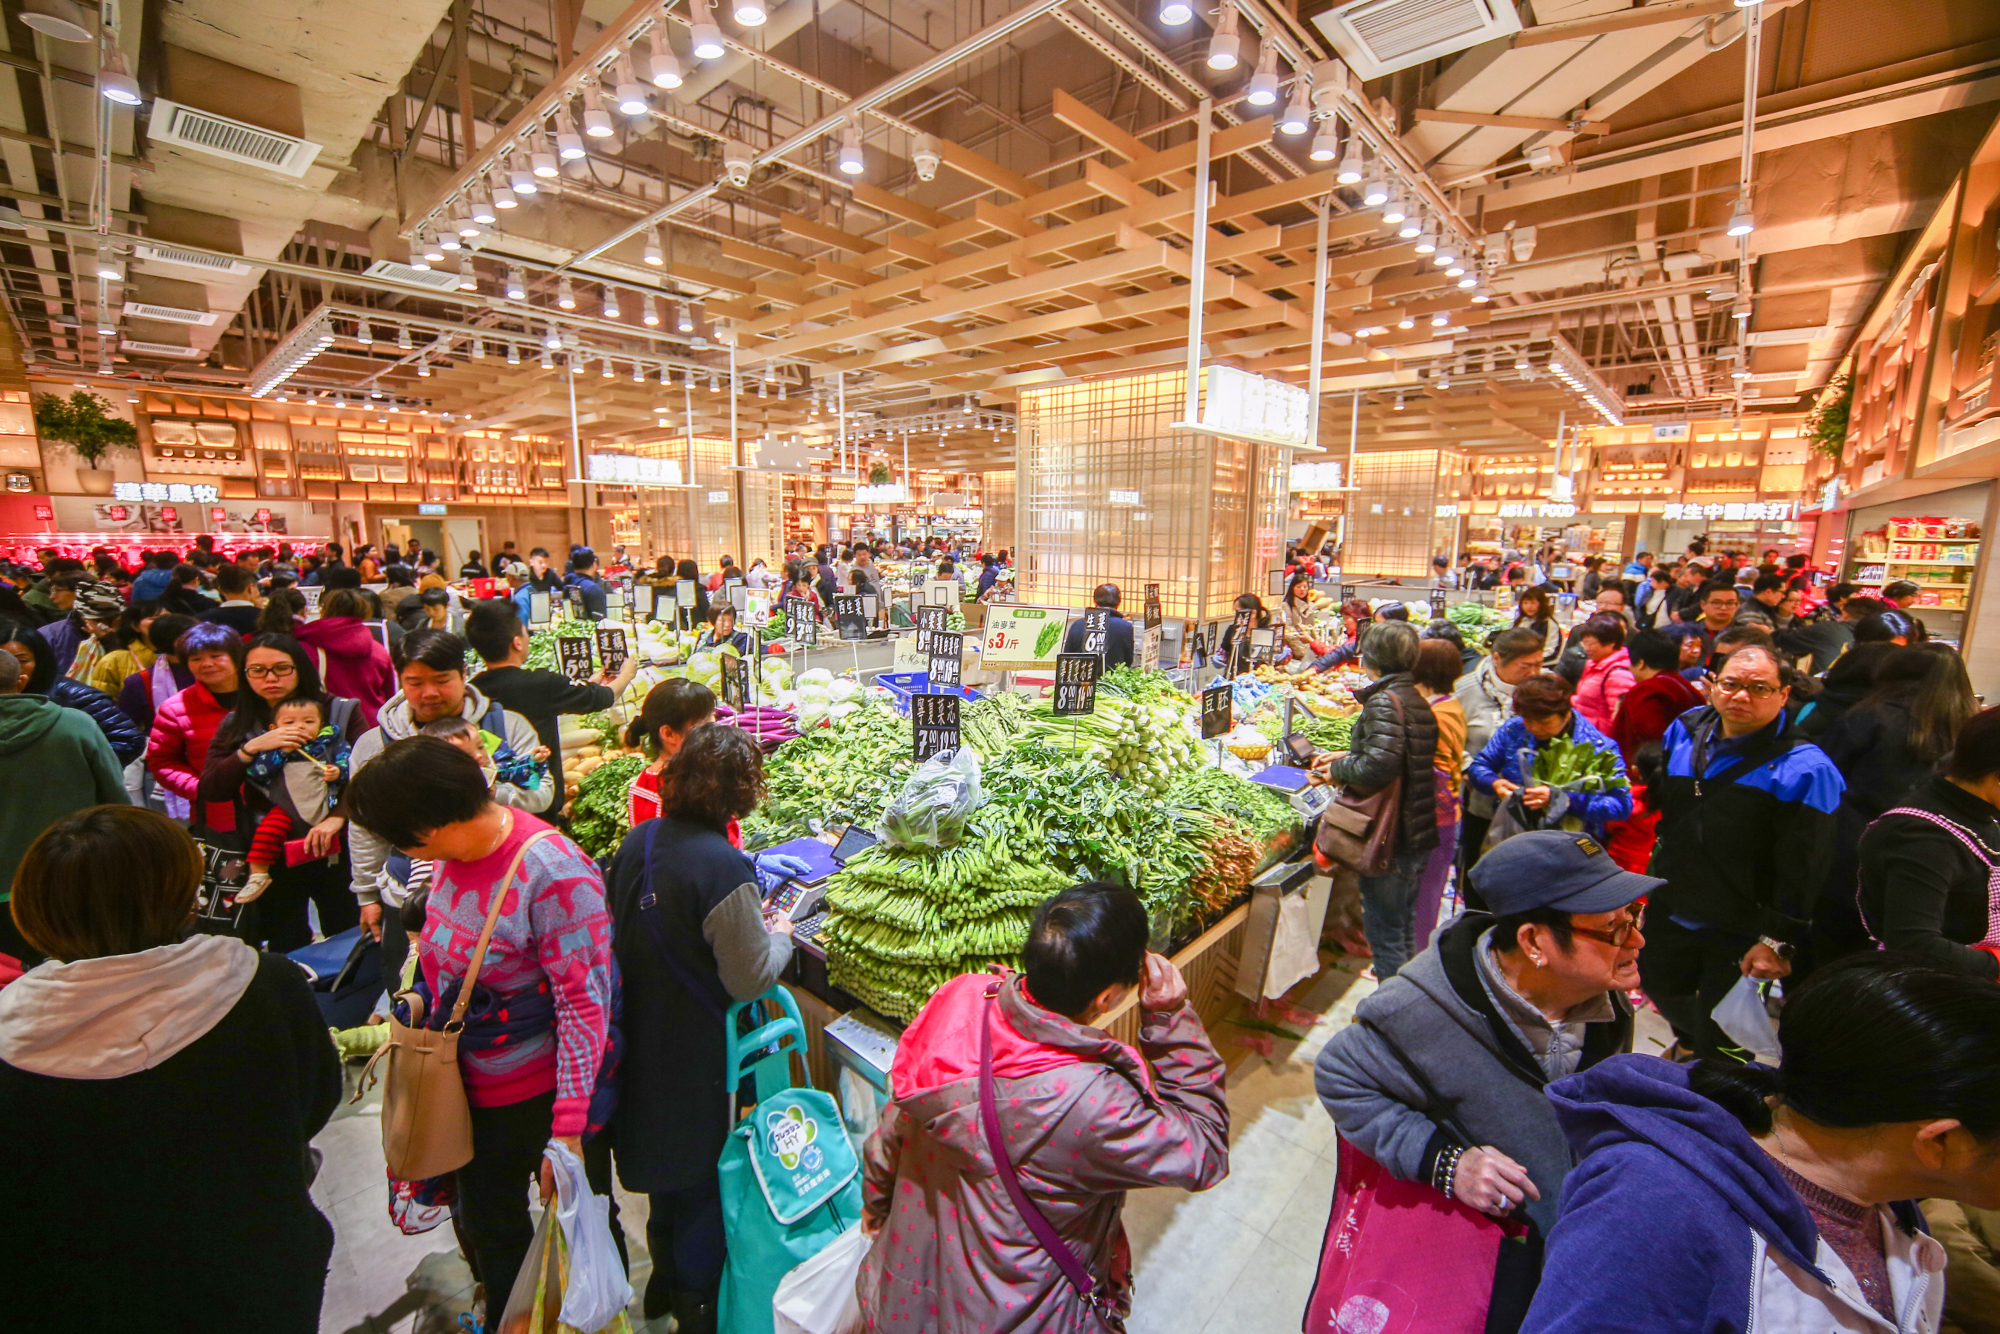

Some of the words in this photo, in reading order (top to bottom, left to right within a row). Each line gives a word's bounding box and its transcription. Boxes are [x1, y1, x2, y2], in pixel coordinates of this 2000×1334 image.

[588, 454, 682, 484] 彩豆品
[113, 482, 219, 503] 建華農牧
[1498, 504, 1533, 517] ASIA
[1538, 504, 1576, 517] FOOD
[913, 574, 925, 586] 08
[838, 598, 863, 616] 西生菜
[991, 620, 1017, 630] 油麥菜
[1086, 612, 1106, 630] 生菜
[917, 697, 956, 725] 寧夏菜芯
[784, 1132, 799, 1150] HY
